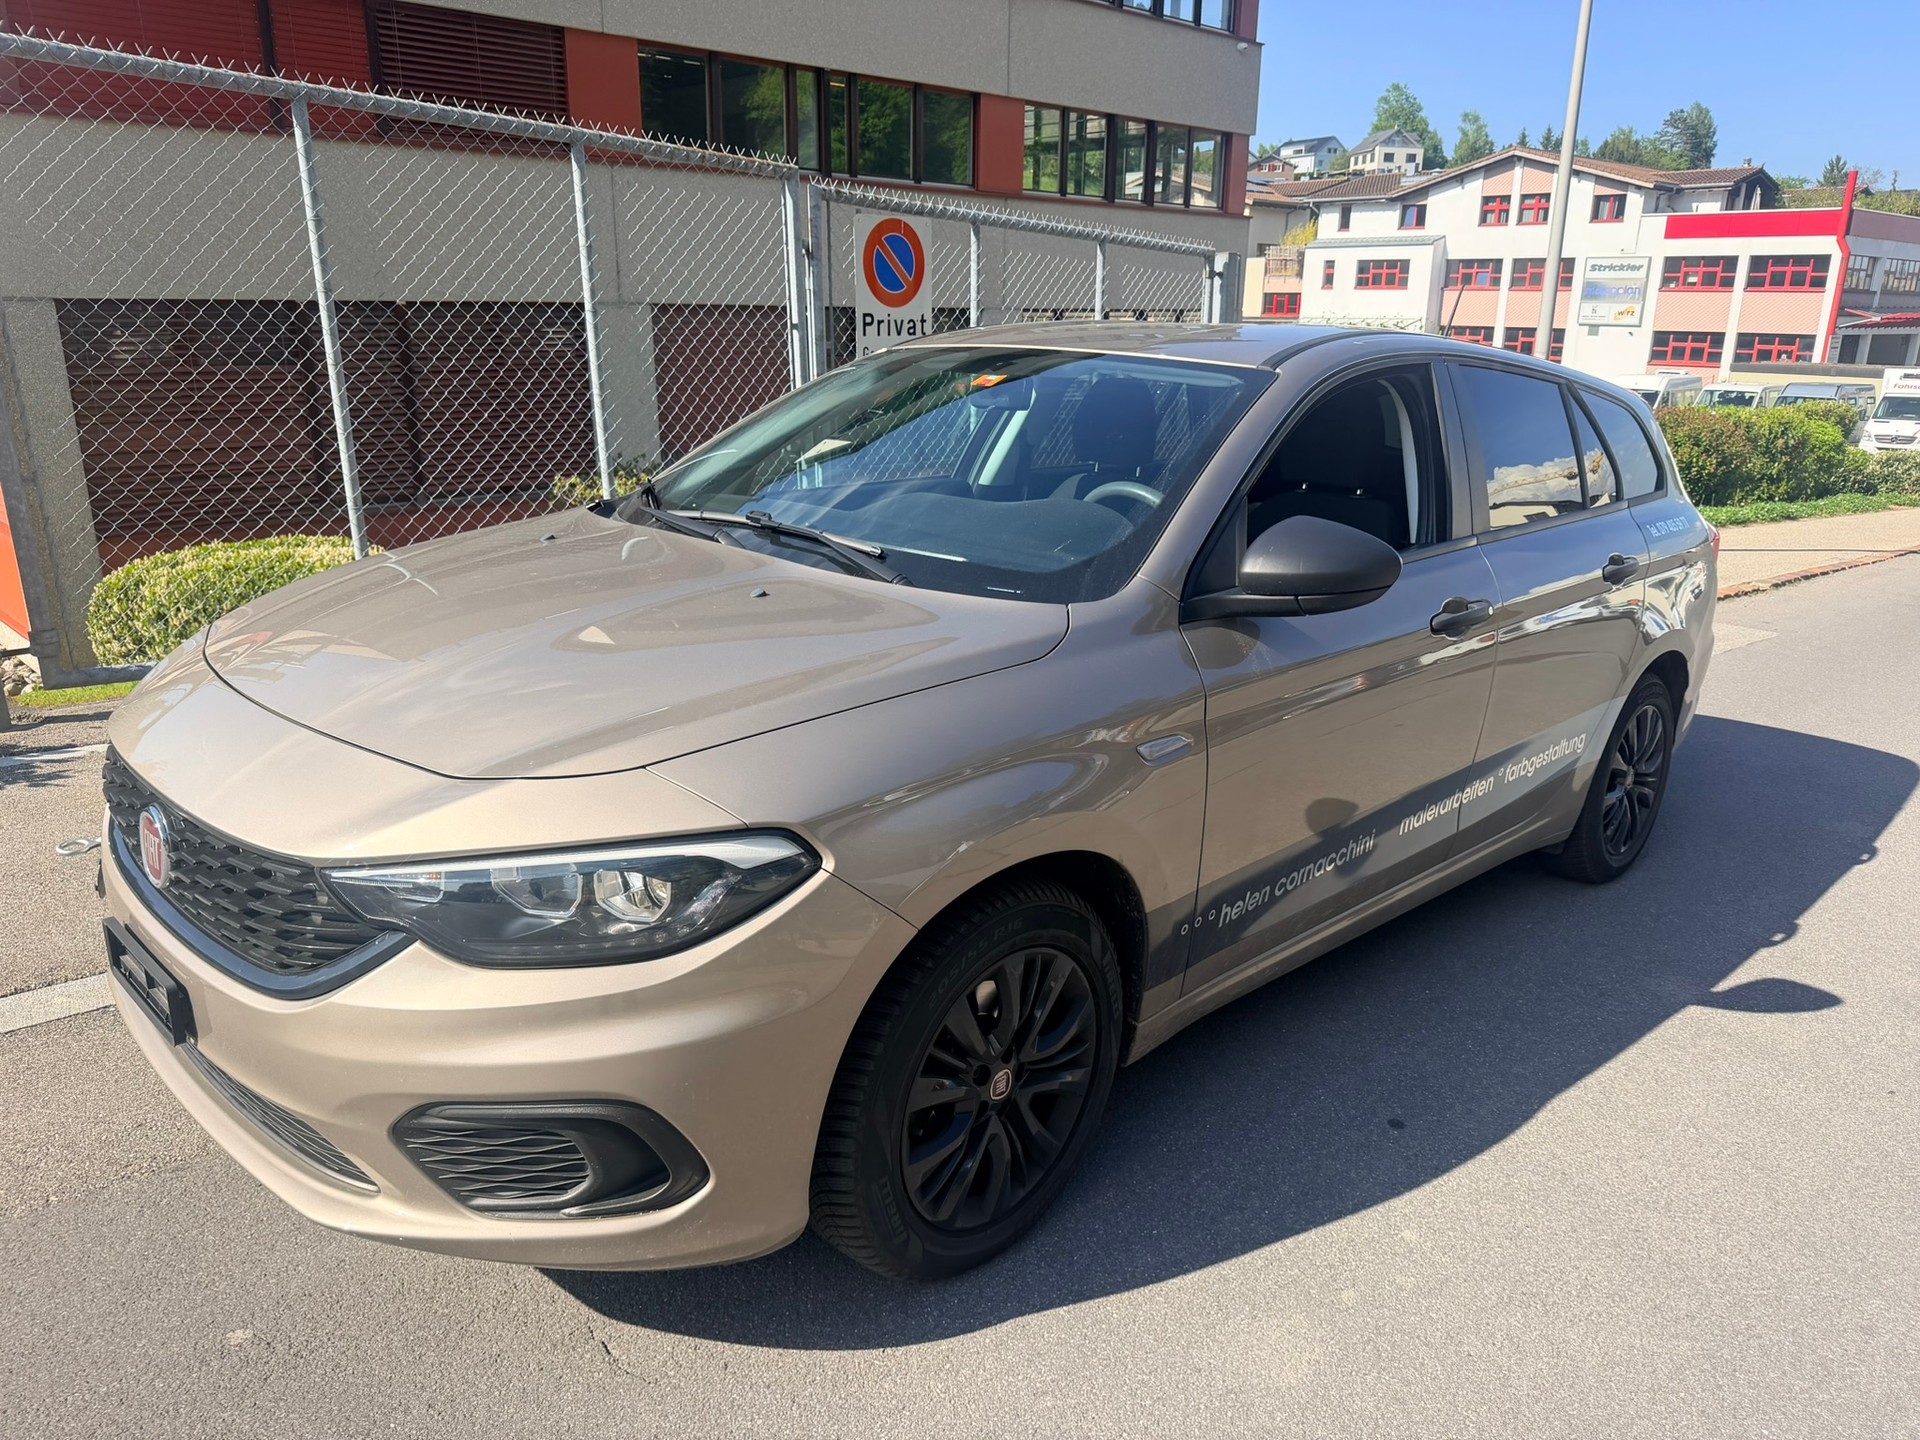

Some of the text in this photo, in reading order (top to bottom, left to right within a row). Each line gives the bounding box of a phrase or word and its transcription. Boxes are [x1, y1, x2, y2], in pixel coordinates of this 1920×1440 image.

[862, 312, 927, 337] Privat
[144, 828, 160, 871] FIAT
[1218, 733, 1587, 928] helen cornacchini malerarbeiten farbgestaltung
